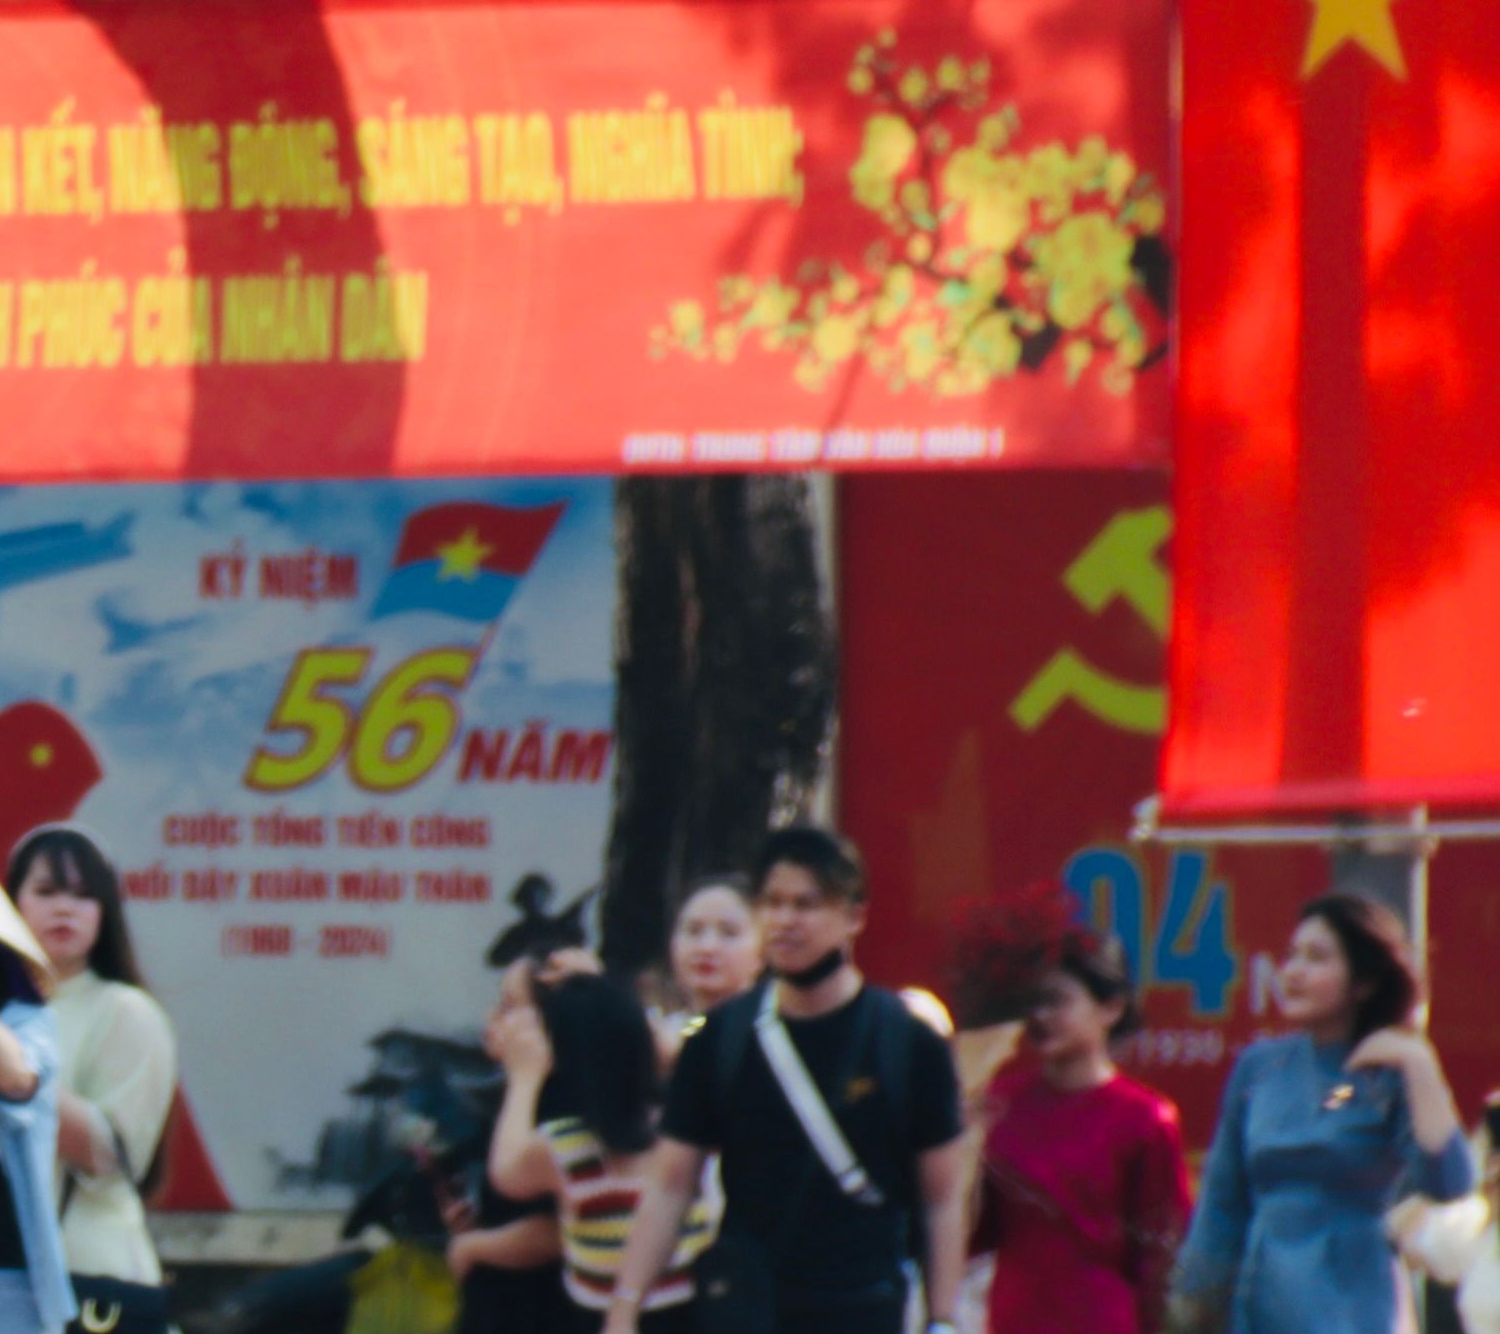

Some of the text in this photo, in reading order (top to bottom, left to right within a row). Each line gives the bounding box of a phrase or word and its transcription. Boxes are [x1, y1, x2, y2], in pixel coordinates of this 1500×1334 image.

[23, 96, 104, 225] KẾT,
[108, 106, 220, 212] NĂNG
[357, 96, 470, 208] SÁNG
[476, 110, 563, 225] TẠO,
[568, 91, 695, 203] NGHĨA
[18, 260, 126, 369] PHÚC
[131, 249, 212, 369] CỦA
[221, 254, 336, 364] NHÂN
[340, 255, 428, 362] DÂN
[259, 546, 359, 610] NIỆM
[242, 645, 615, 794] 56 NĂM
[163, 811, 242, 851] CUỘC
[409, 810, 491, 849] CÔNG
